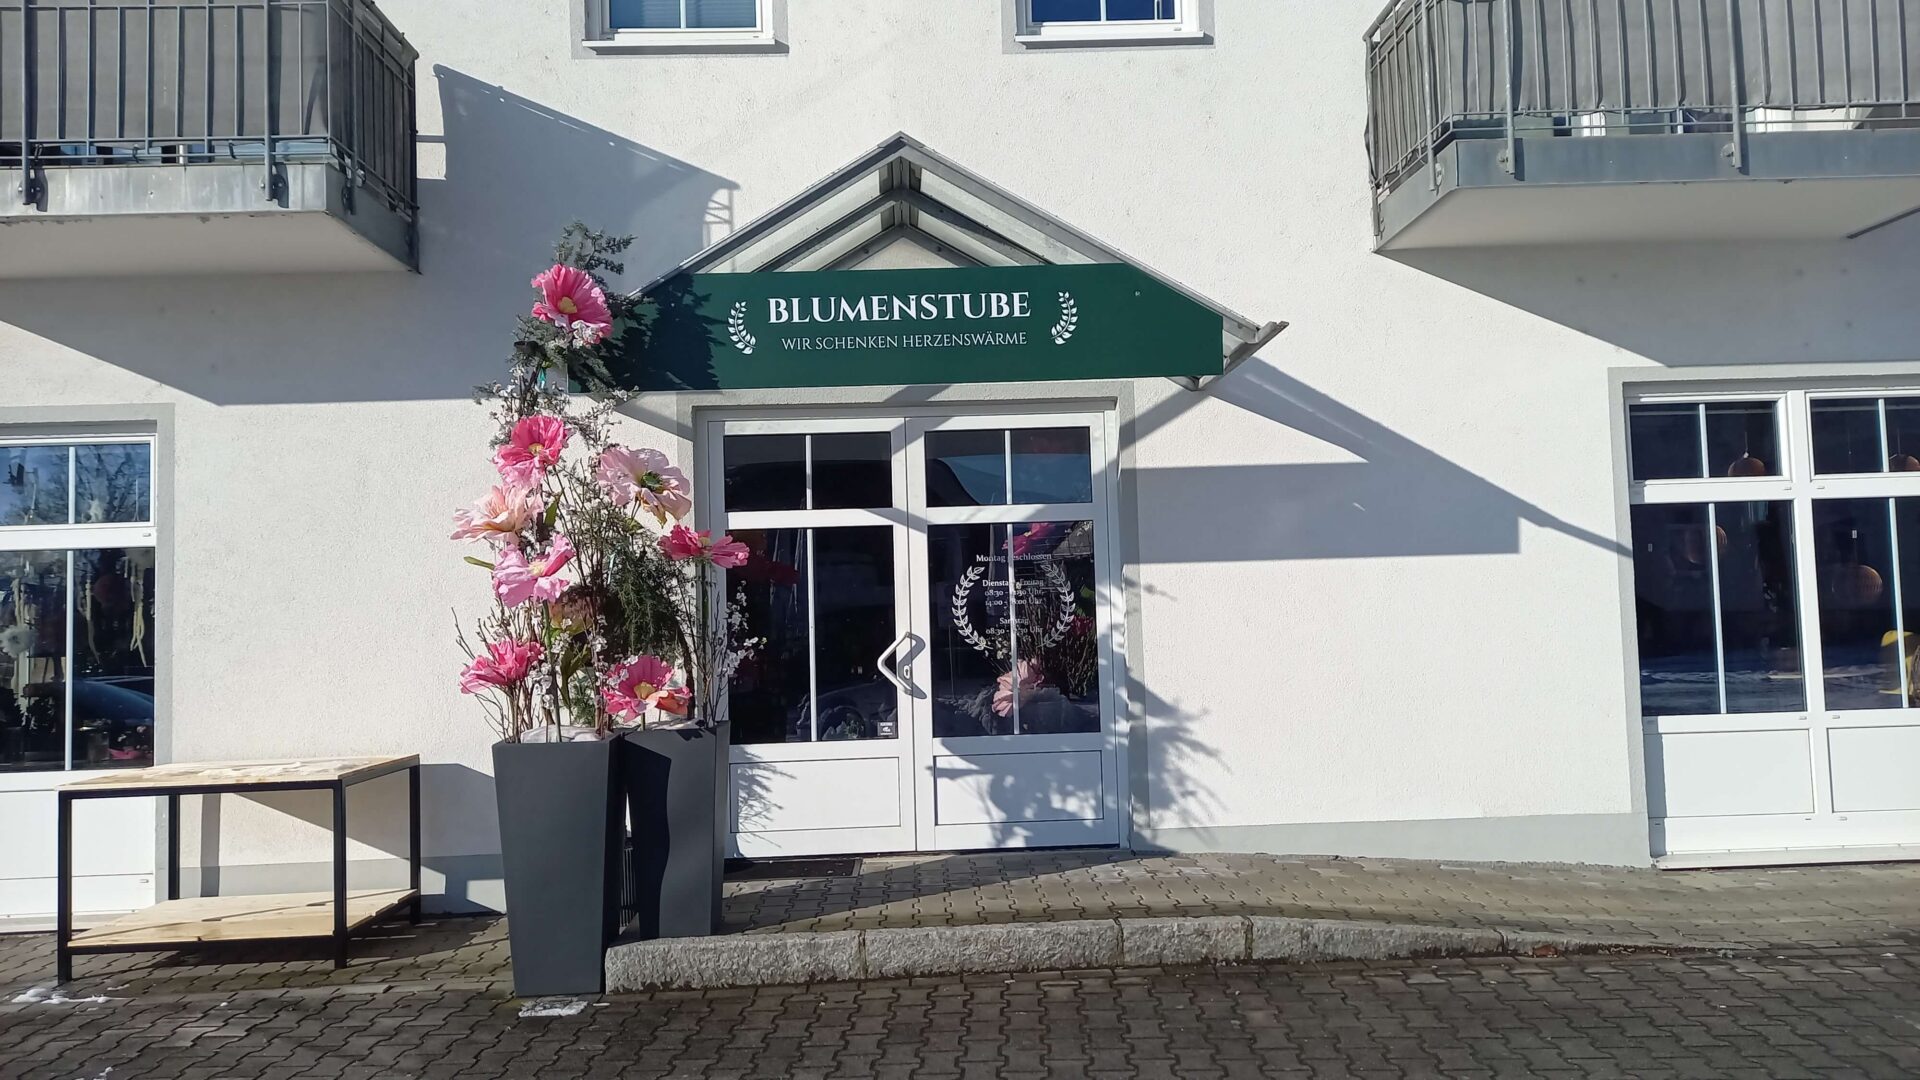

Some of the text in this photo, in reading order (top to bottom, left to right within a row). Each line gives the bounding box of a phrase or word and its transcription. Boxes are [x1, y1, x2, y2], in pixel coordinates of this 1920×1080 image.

[767, 291, 1031, 324] BLUMENSTUBE
[781, 330, 1027, 351] WIR SCHENKEN HERZENSWÄRME
[976, 552, 1052, 563] Montag eschlossen
[982, 579, 1013, 587] Diensta
